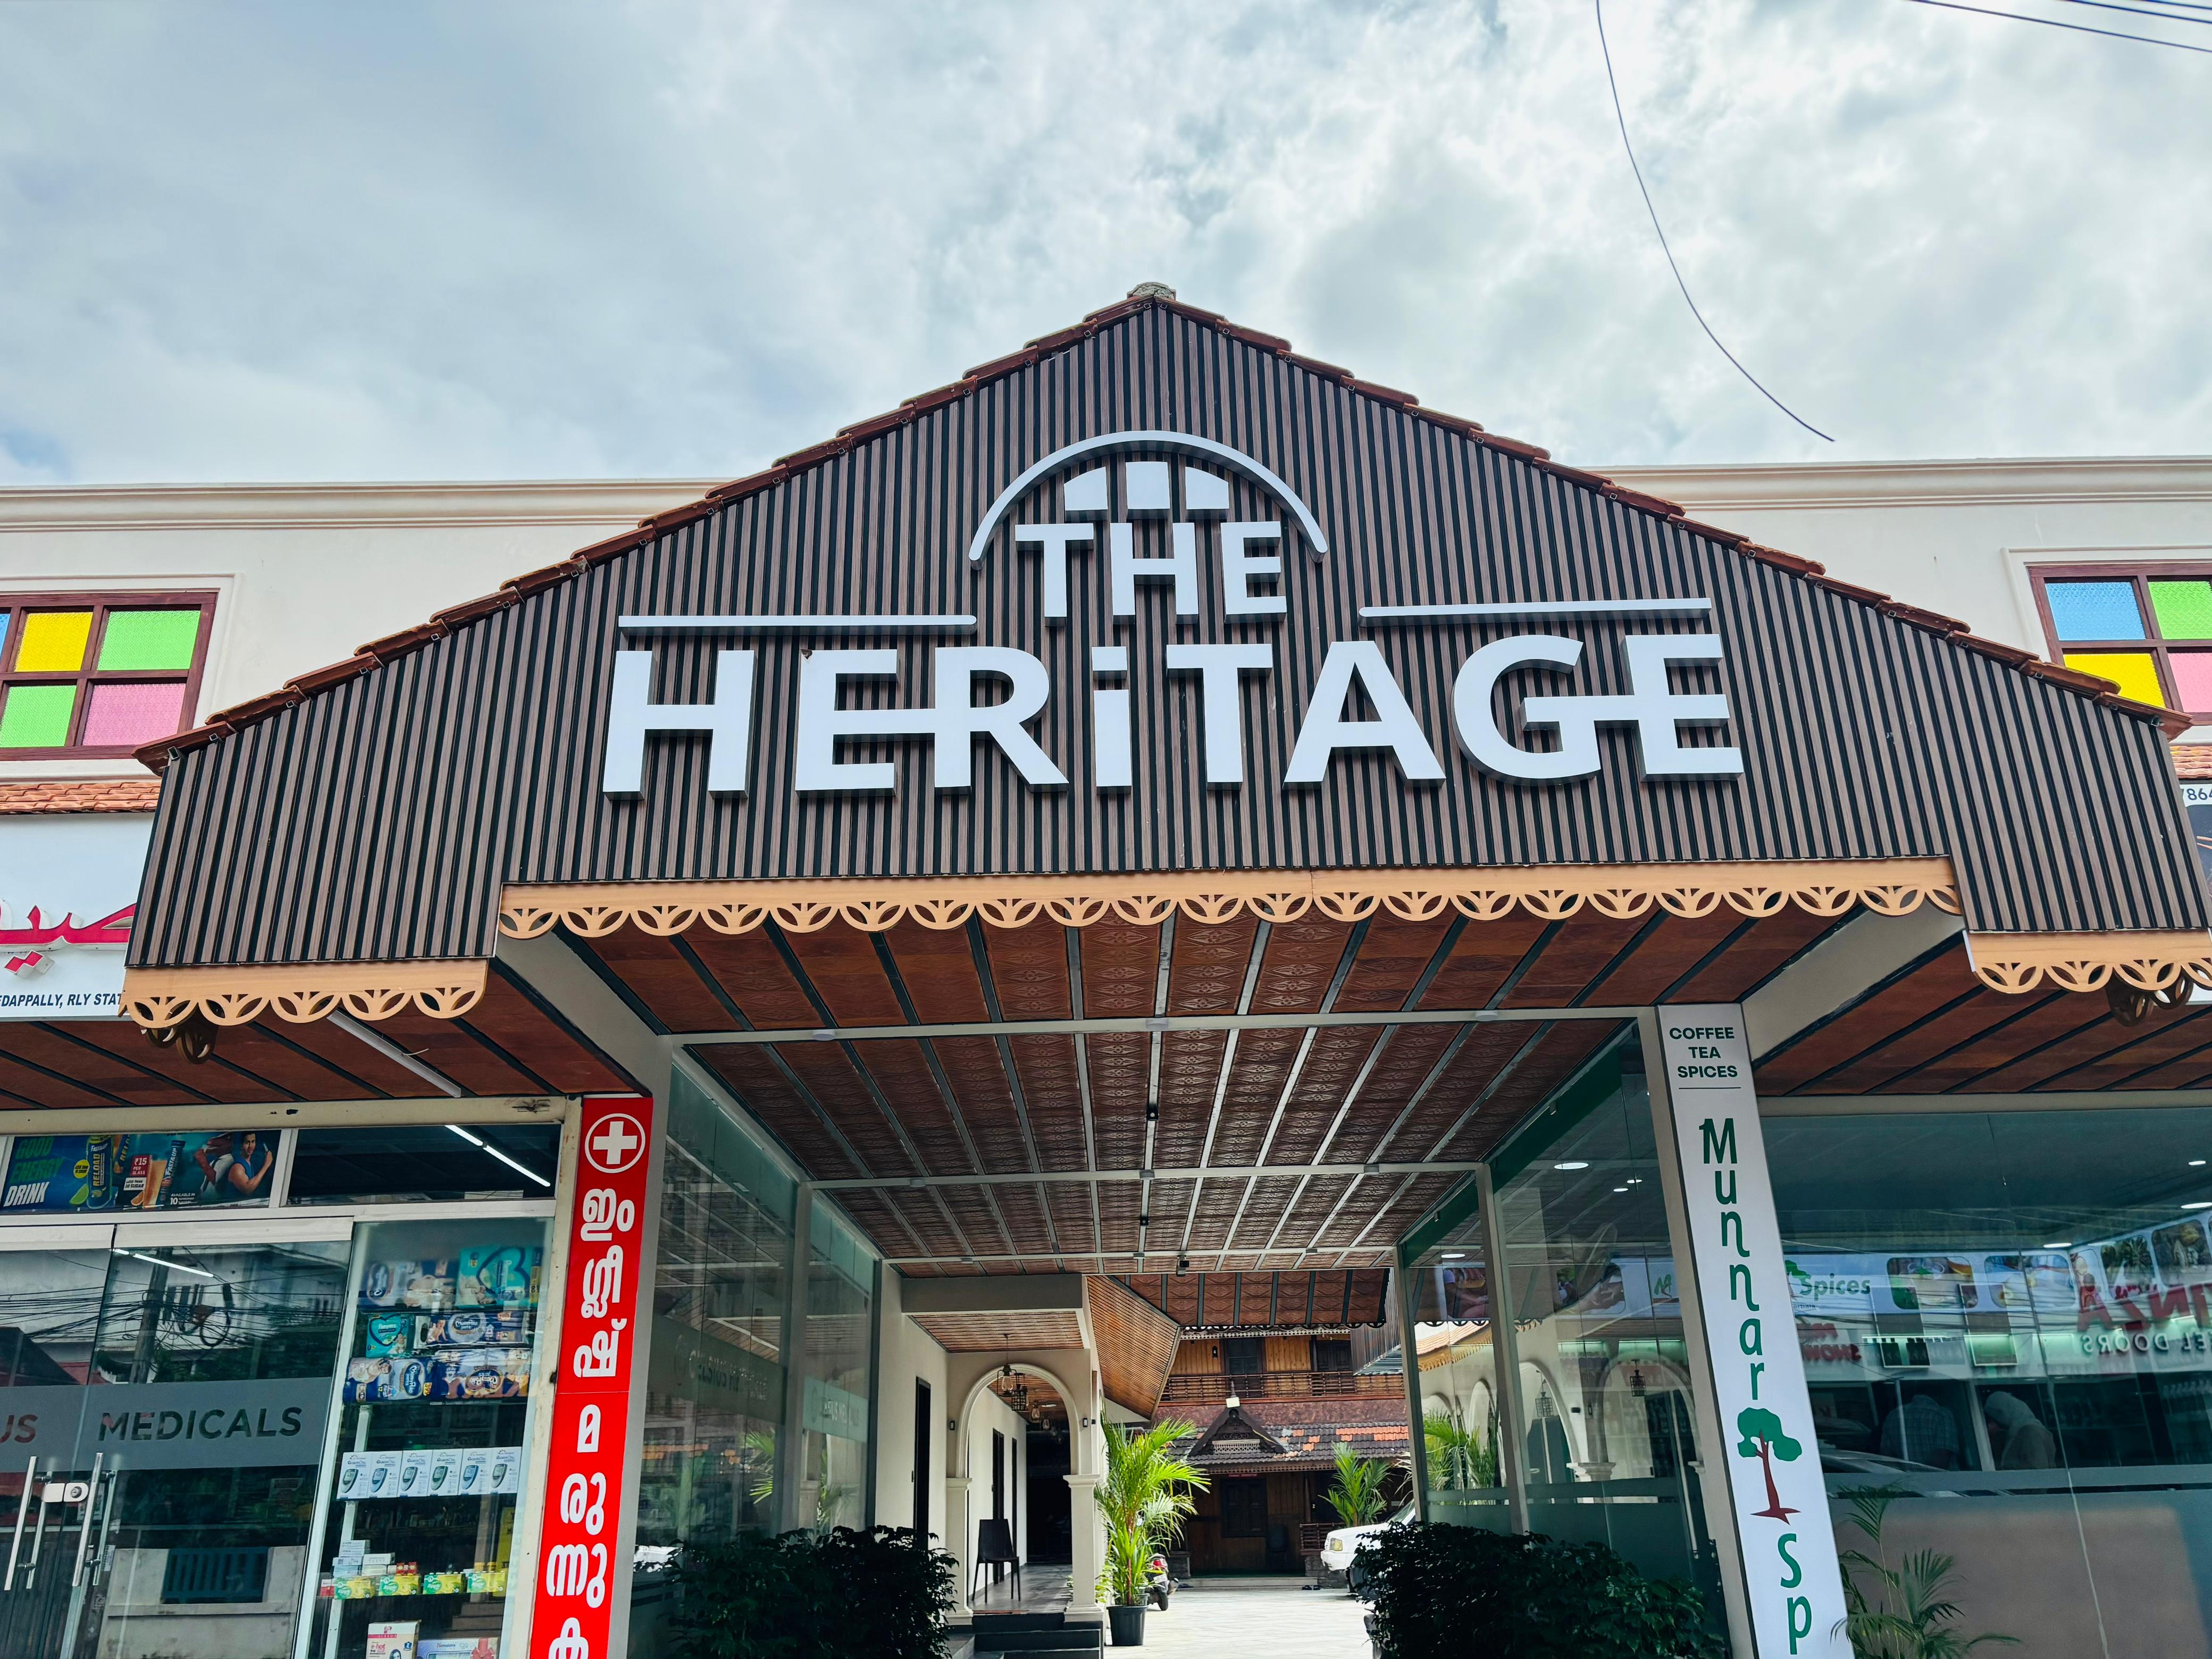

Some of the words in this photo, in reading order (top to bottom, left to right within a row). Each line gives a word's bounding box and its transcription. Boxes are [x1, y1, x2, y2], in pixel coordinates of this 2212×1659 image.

[1015, 522, 1287, 627] THE
[67, 994, 91, 1006] RLY
[1669, 1027, 1735, 1040] COFFEE
[1688, 1046, 1721, 1058] TEA
[1677, 1066, 1738, 1078] SPICES
[15, 1136, 54, 1160] GOOD
[9, 1157, 65, 1185] ENERGY
[134, 1157, 147, 1166] ₹15
[3, 1182, 50, 1208] DRINK
[1800, 1273, 1871, 1301] Spices
[98, 1407, 303, 1442] MEDICALS
[1778, 1533, 1812, 1655] Sp
